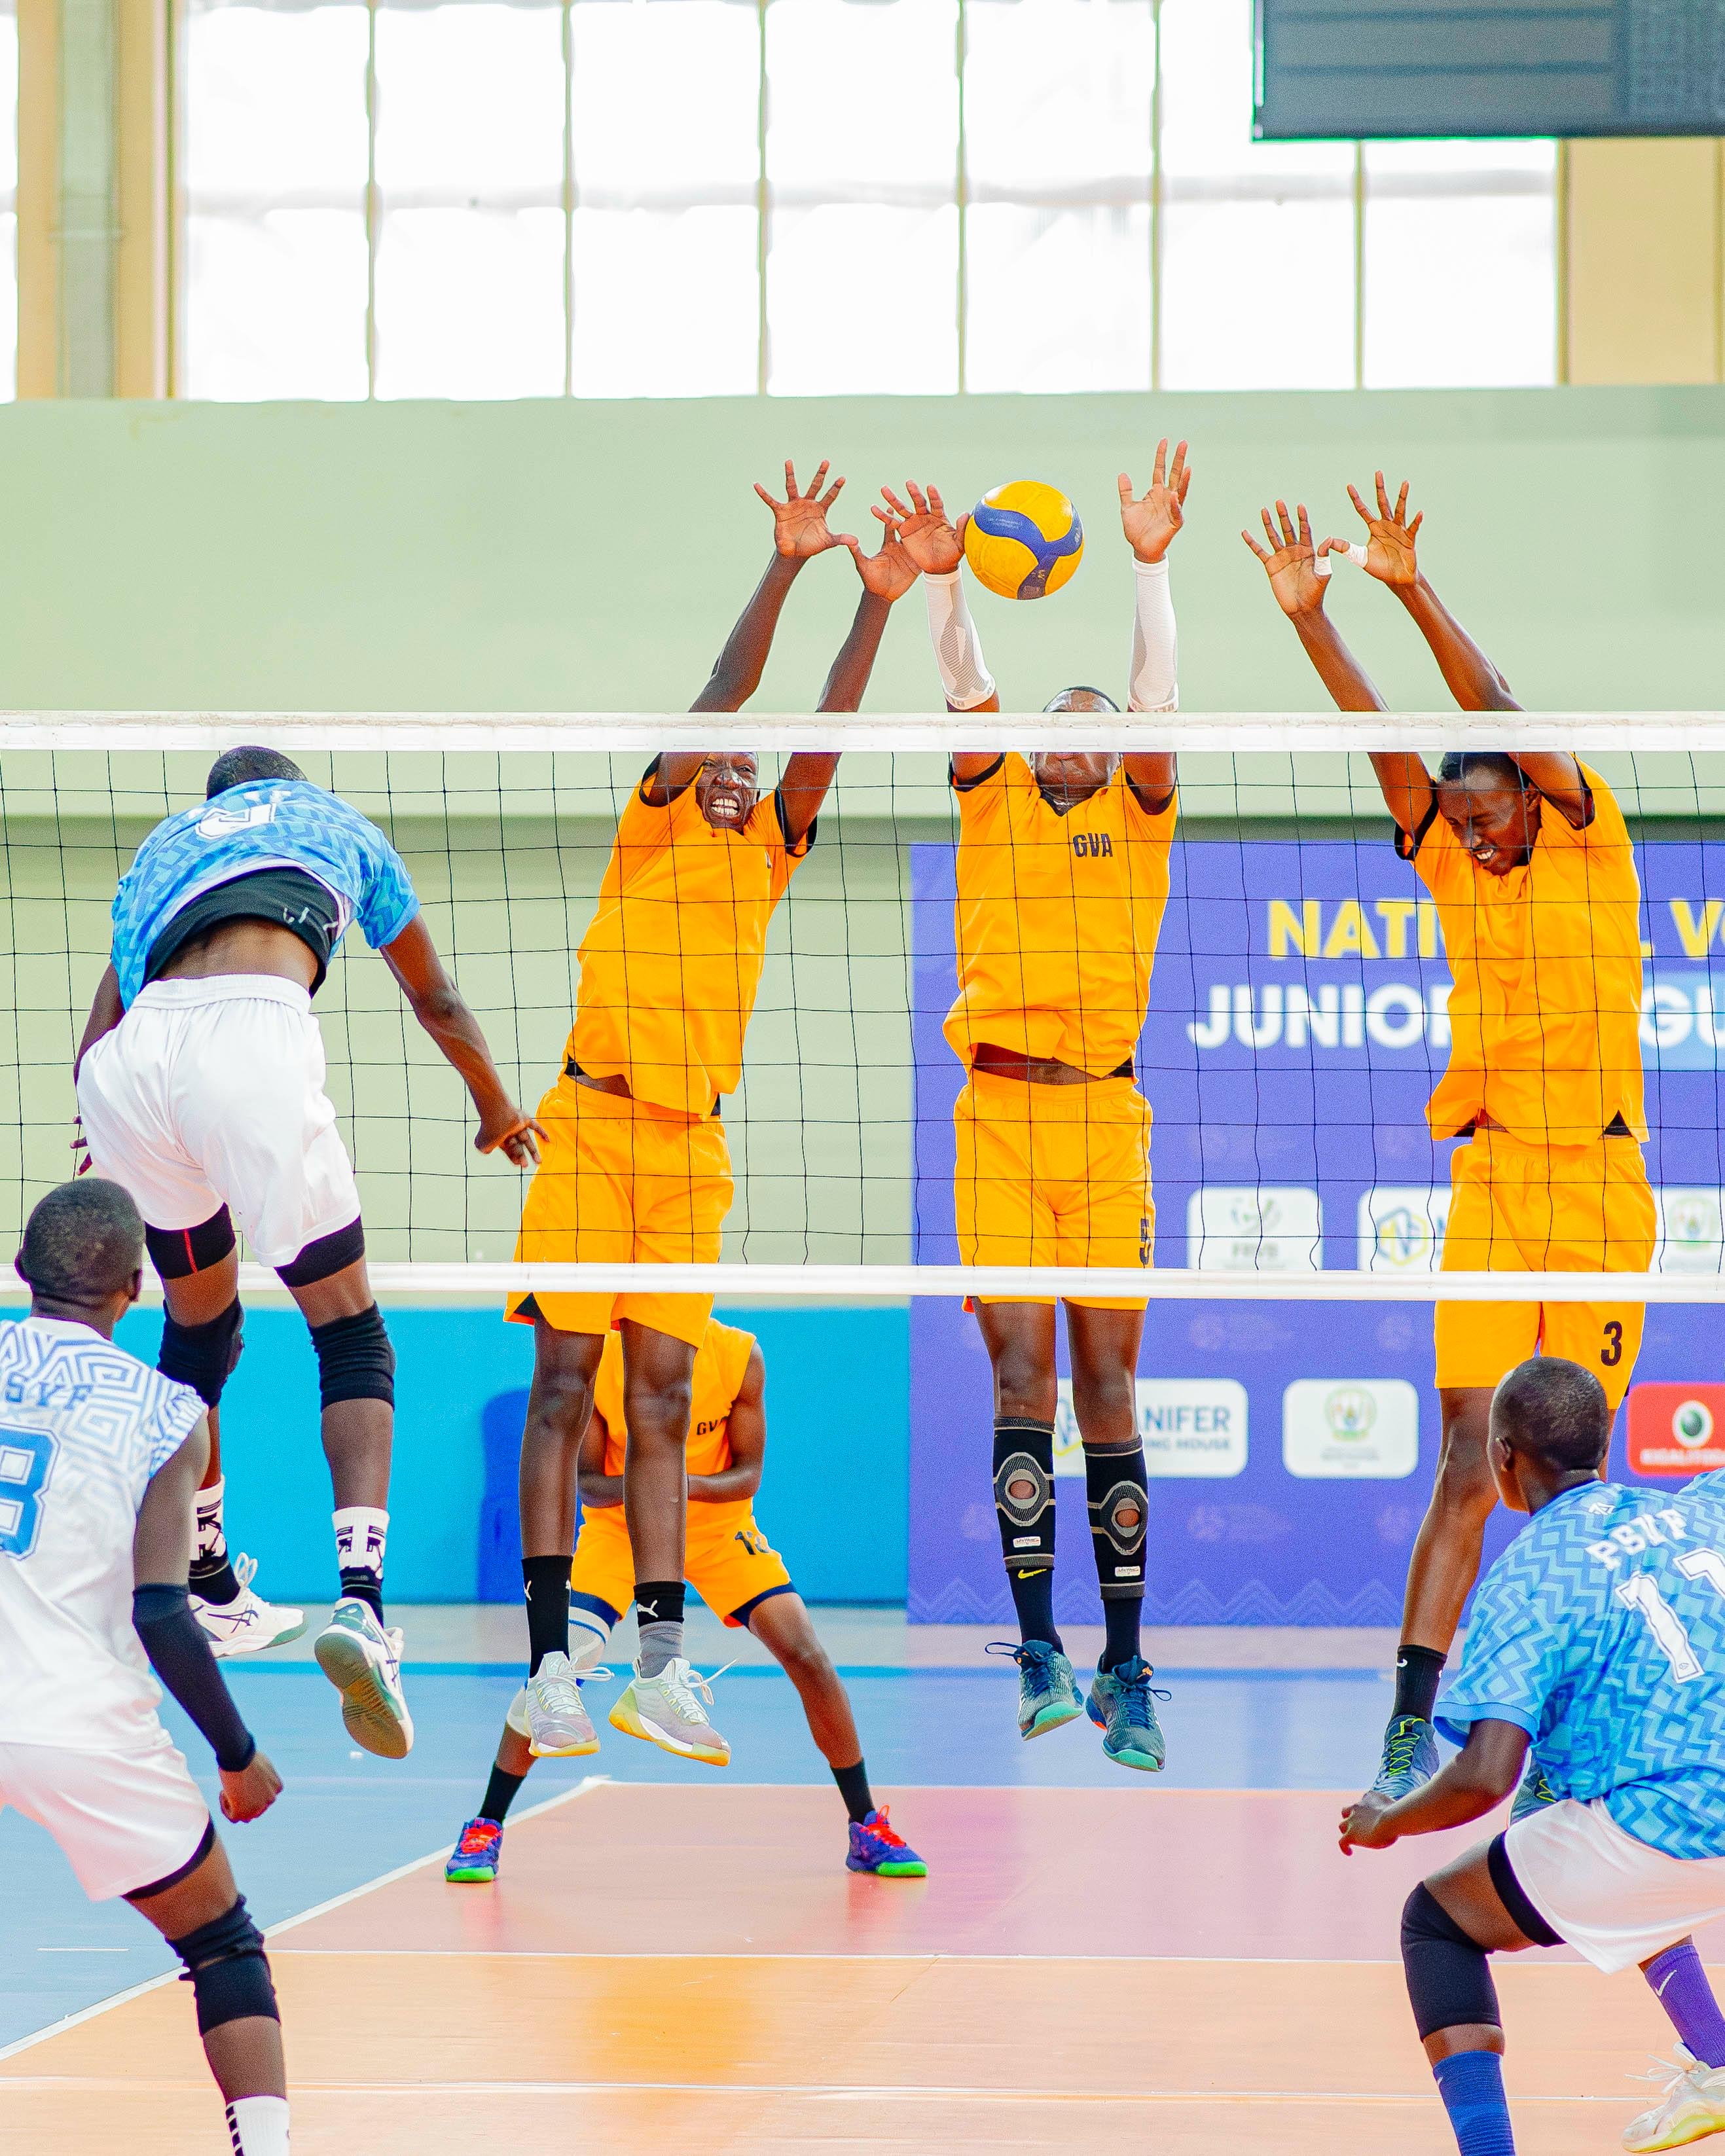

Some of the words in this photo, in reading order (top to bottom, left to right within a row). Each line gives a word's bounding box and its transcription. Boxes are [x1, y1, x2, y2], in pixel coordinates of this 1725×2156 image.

[1072, 833, 1113, 857] GVA
[1269, 898, 1445, 960] NATI
[1669, 898, 1725, 960] V
[1139, 1218, 1152, 1265] 5
[1601, 1321, 1622, 1367] 3
[5, 1372, 94, 1410] SYF
[1144, 1405, 1231, 1432] NIFER
